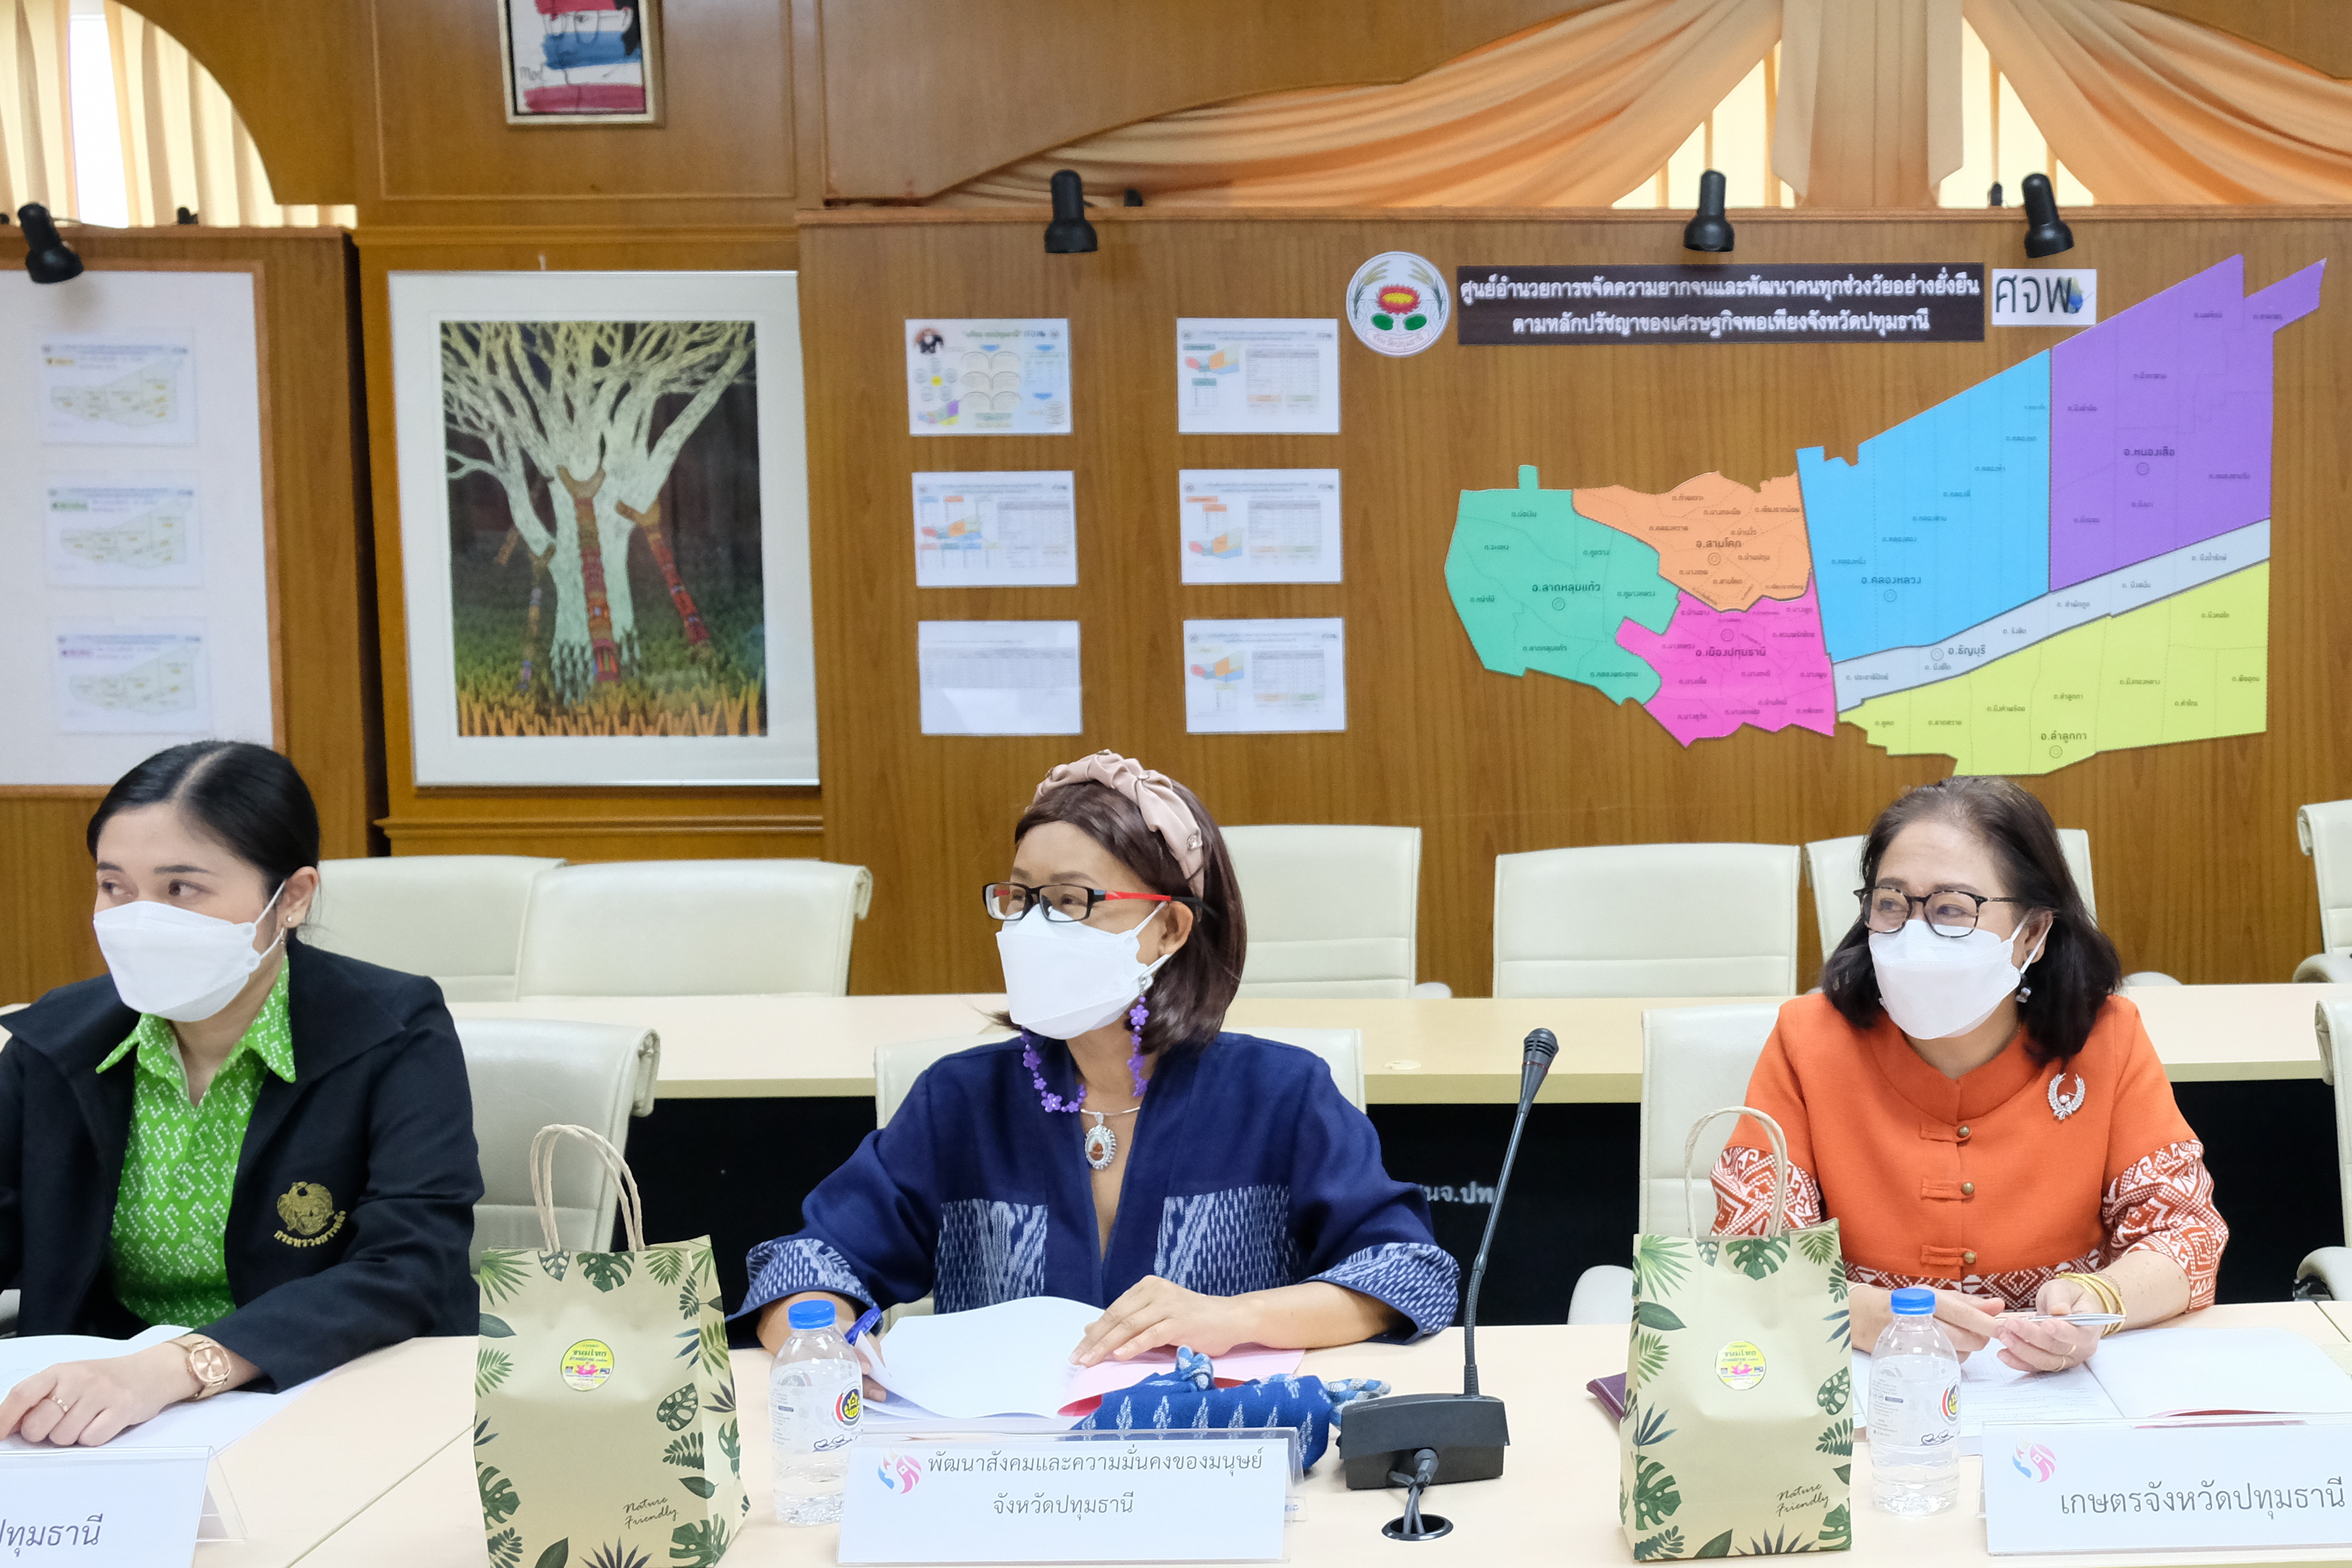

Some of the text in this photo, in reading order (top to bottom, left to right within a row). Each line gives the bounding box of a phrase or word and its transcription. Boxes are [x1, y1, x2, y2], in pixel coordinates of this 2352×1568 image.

[1461, 266, 1980, 305] ศูนย์อำนวยการขจัดความยากจนและพัฒนาคนทุกช่วงวัยอย่างยั่งยืน
[1512, 307, 1930, 337] ตามหลักปรัชญาของเศรษฐกิจพอเพียงจังหวัดปทุมธานี
[2124, 446, 2175, 456] อ.หนองเสือ
[1696, 537, 1742, 549] อ.สามโคก
[1532, 581, 1600, 594] อ.ลาดหลุมแก้ว
[1696, 646, 1766, 657] อ.เมืองปทุมธานี
[1948, 644, 1985, 657] อ.ธัญบุรี
[2041, 730, 2087, 743] อ.ลำลูกกา
[928, 1445, 1264, 1477] พัฒนาสังคมและความมั่นคงของมนุษย์
[1776, 1484, 1822, 1501] Nature
[2061, 1476, 2346, 1520] เกษตรจังหวัดปทุมธานี
[623, 1497, 668, 1513] Nature
[993, 1492, 1134, 1520] จังหวัดปทุมธานี
